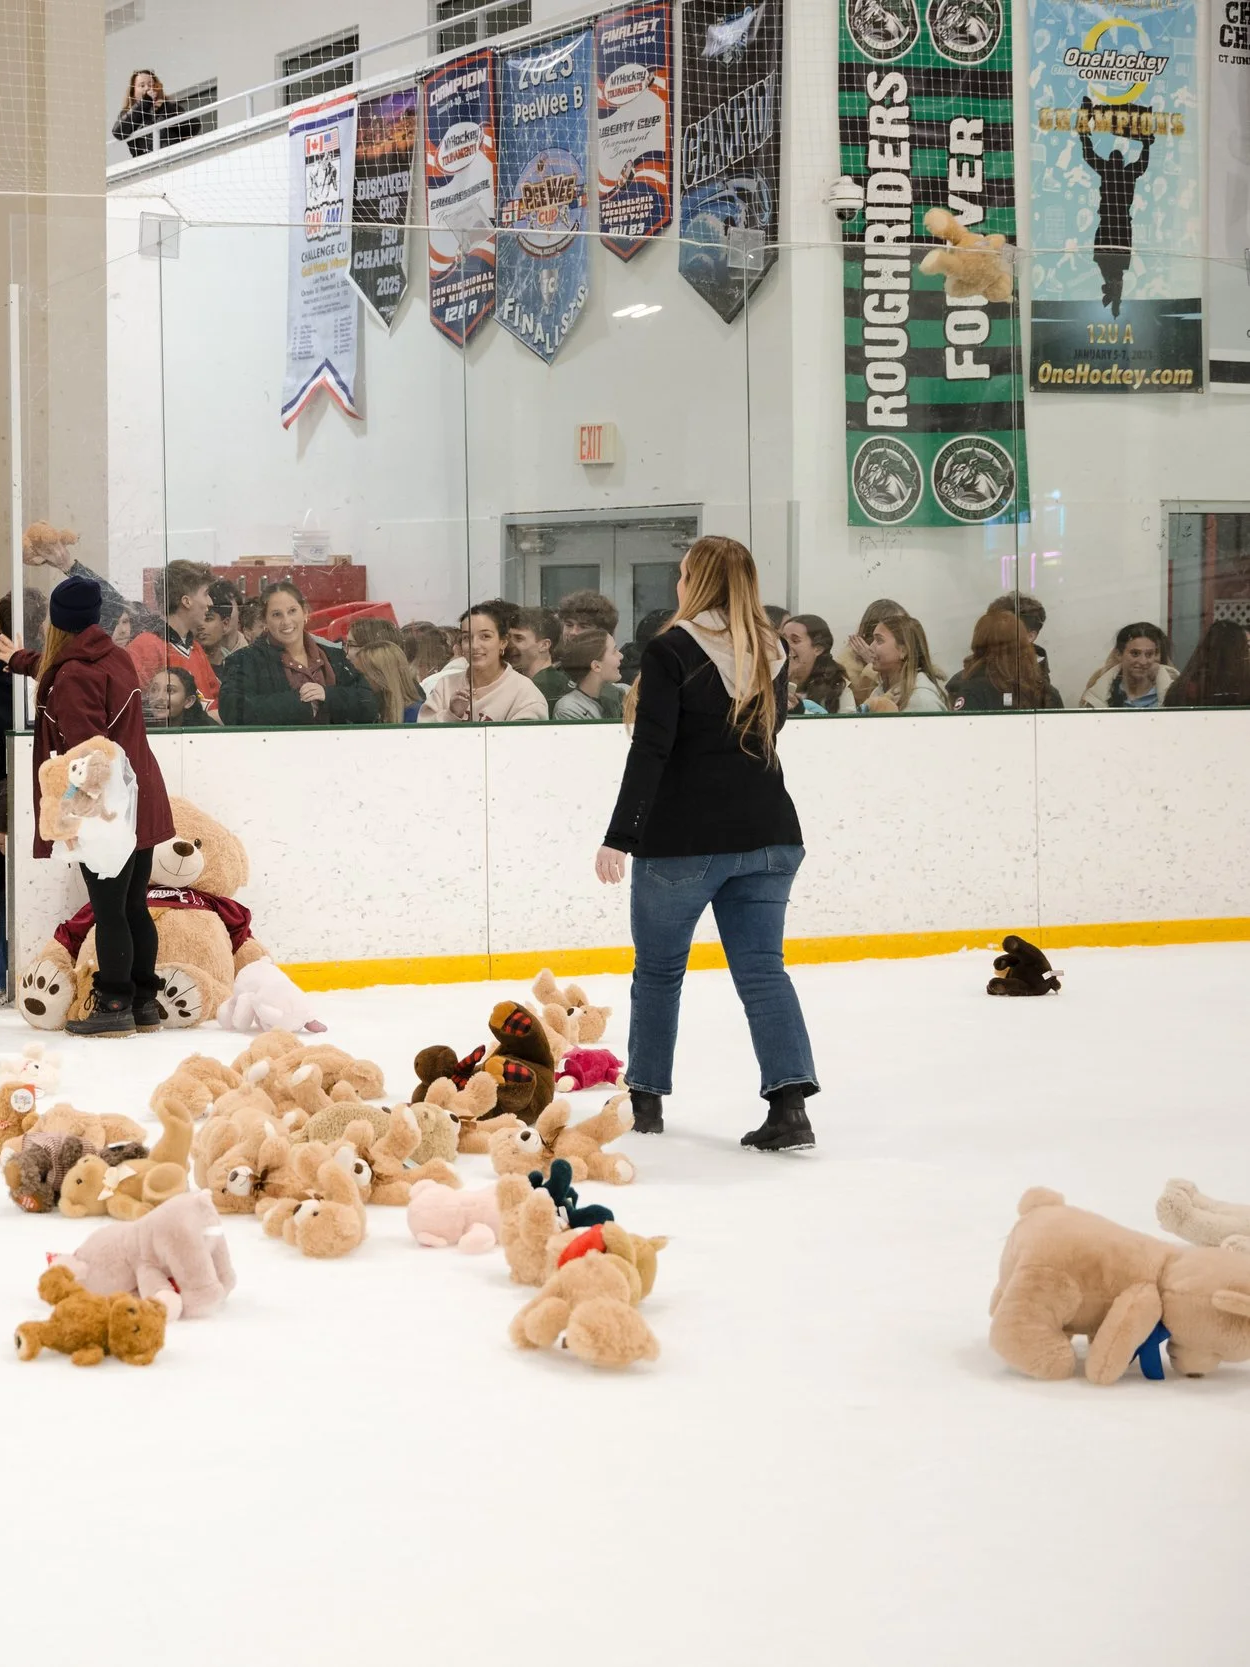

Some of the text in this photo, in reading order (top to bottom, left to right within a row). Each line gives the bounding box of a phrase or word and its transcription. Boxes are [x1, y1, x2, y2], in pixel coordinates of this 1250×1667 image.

[600, 18, 660, 45] FINALIST
[1063, 47, 1169, 75] OneHockey
[1218, 54, 1229, 63] CT
[429, 68, 487, 107] CHAMPION
[1079, 68, 1154, 82] CONNECTICUT
[514, 85, 584, 127] PeeWee B
[637, 115, 662, 130] CUP
[1039, 108, 1185, 136] CHAMPIONS
[379, 197, 401, 220] CUP
[537, 207, 558, 227] CUP
[301, 244, 335, 263] CHALLENGE
[863, 71, 912, 427] ROUGHRIDERS
[945, 117, 991, 379] FOVER
[377, 275, 401, 296] 2025
[432, 271, 494, 298] CONGRESSIONAL
[432, 295, 446, 308] CUP
[468, 299, 478, 316] A
[1087, 323, 1134, 344] 12U A
[1038, 361, 1193, 389] OneHockey.com
[580, 425, 603, 460] EXIT
